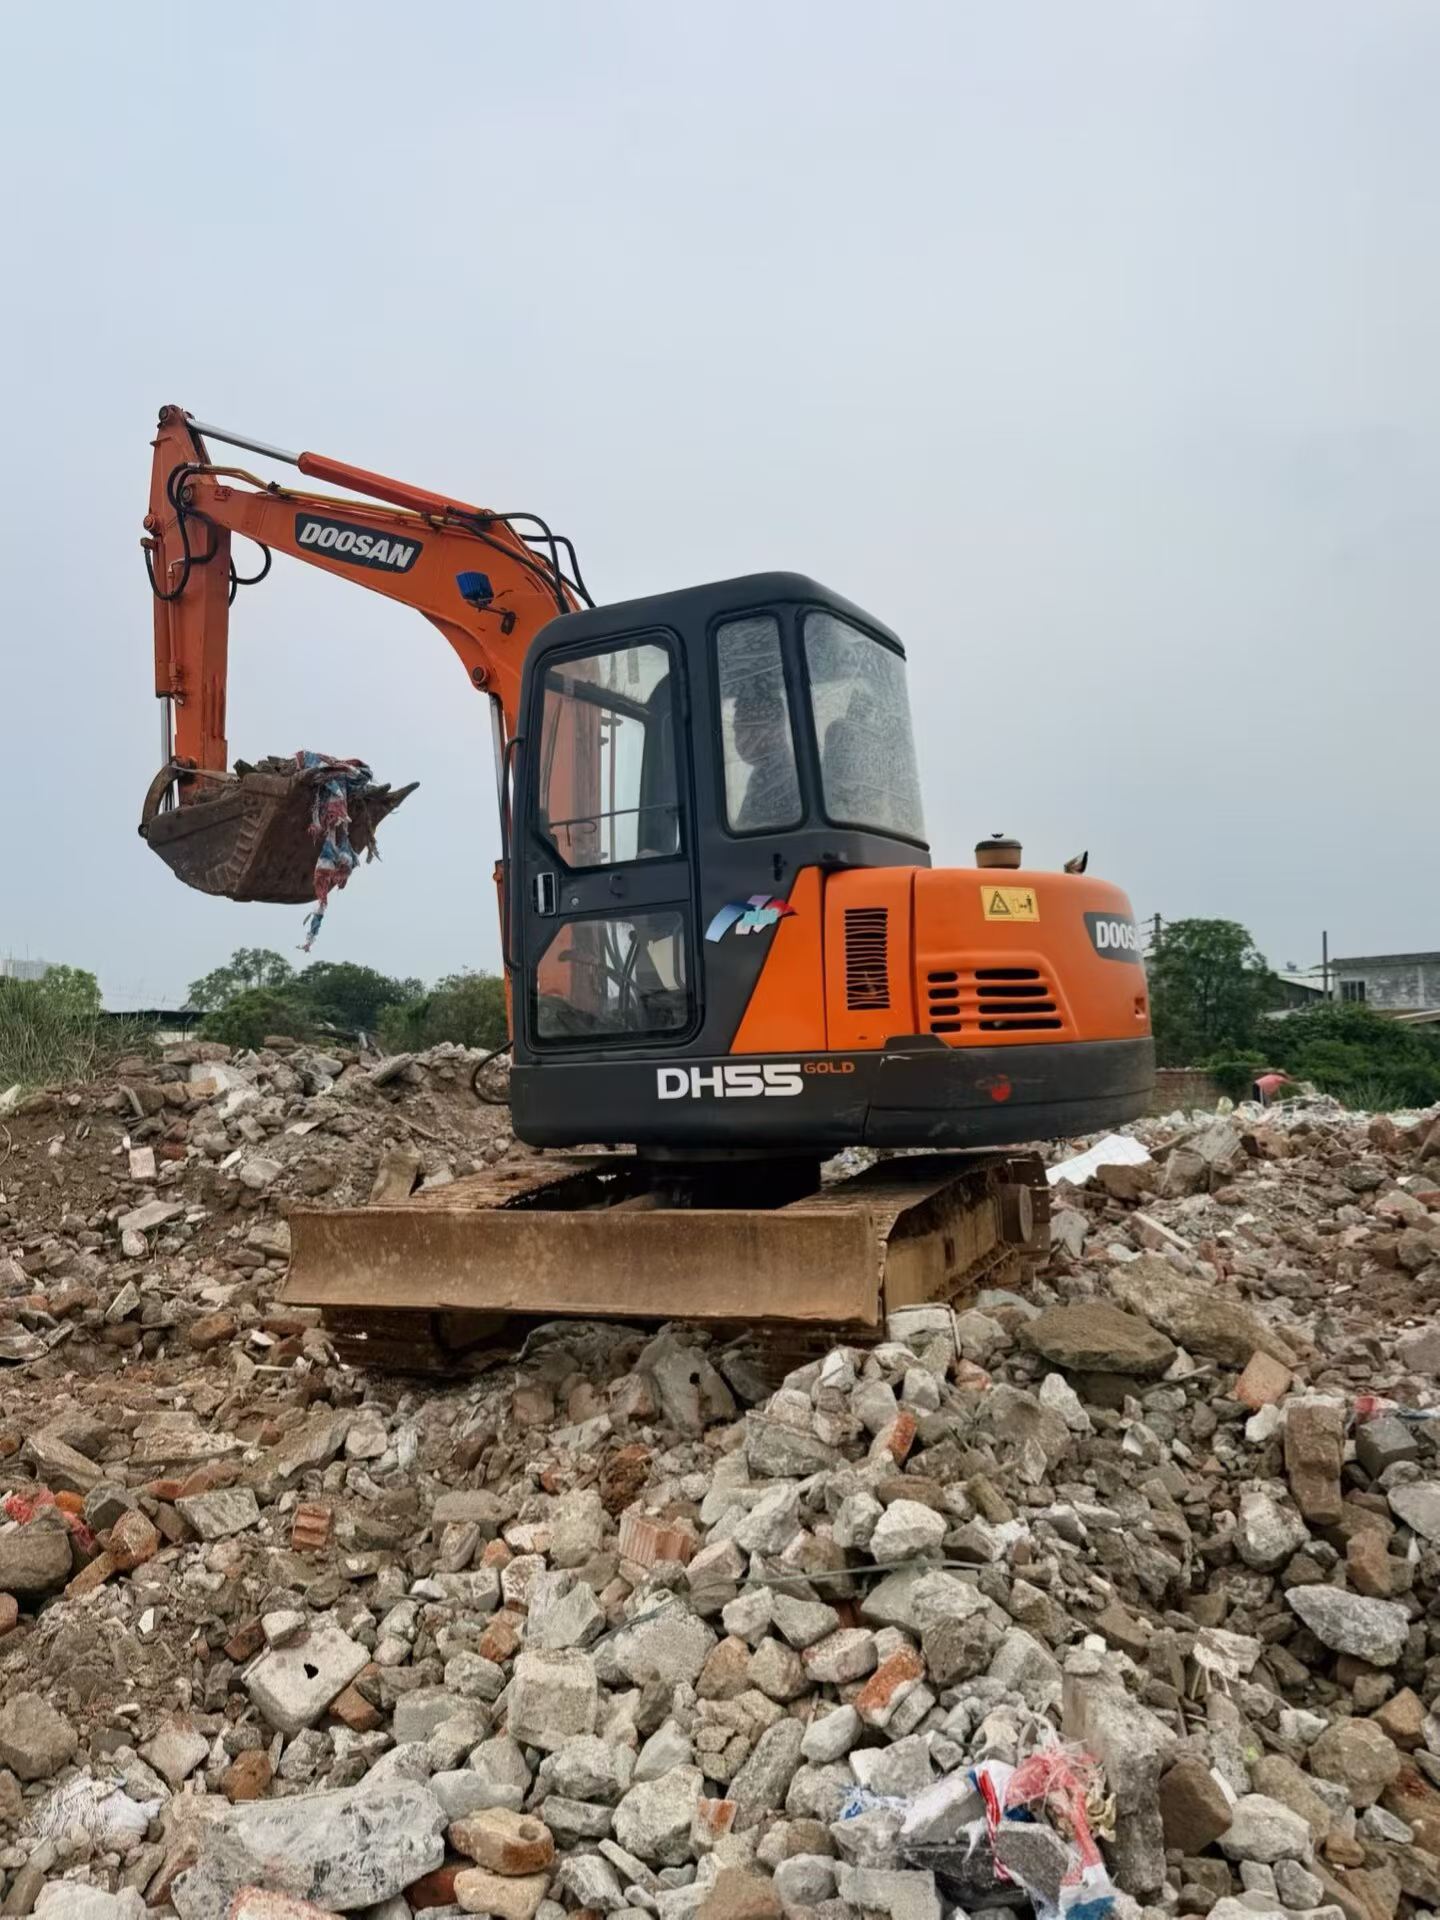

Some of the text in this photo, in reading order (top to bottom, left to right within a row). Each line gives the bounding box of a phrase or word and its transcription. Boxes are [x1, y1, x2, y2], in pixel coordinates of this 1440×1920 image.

[299, 522, 415, 568] DOOSAN
[656, 1061, 855, 1100] DH55 GOLD
